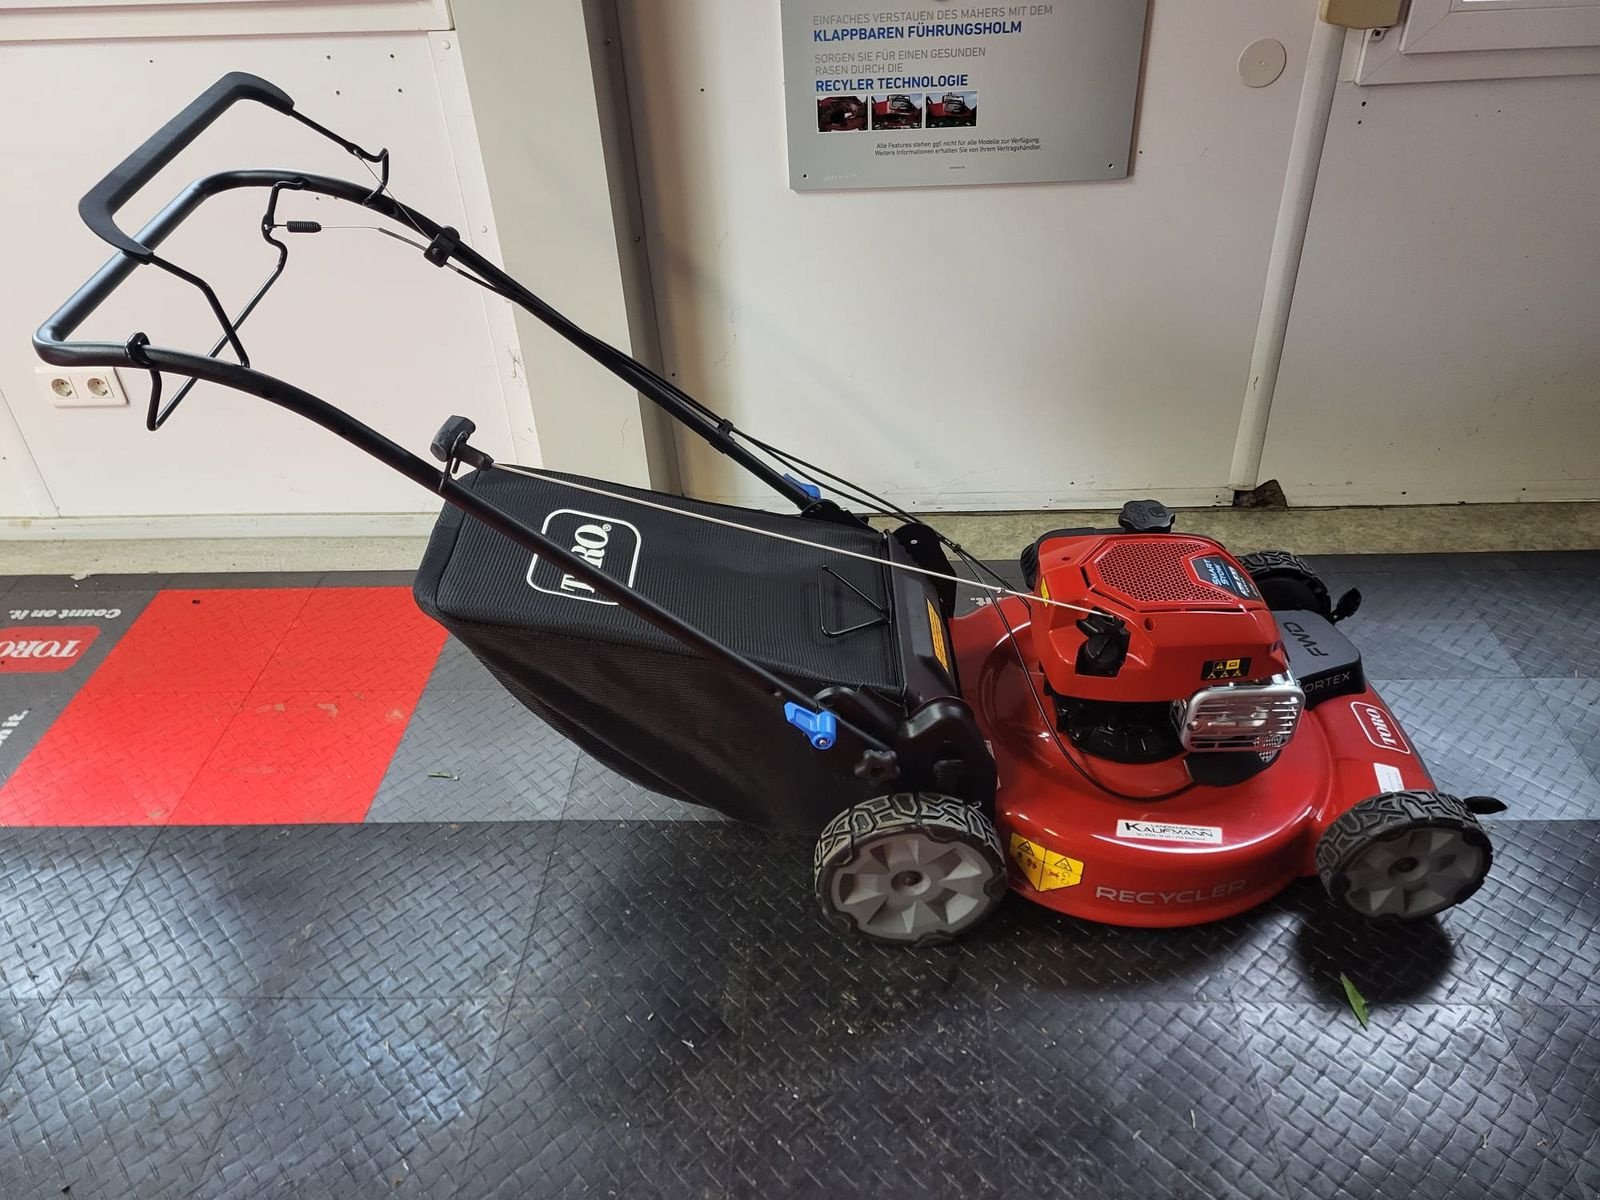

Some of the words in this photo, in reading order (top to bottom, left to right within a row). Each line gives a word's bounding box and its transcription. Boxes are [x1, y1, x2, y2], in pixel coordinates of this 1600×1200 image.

[812, 13, 870, 26] EINFACHES
[872, 10, 934, 23] VERSTAUEN
[937, 9, 958, 21] DES
[1008, 5, 1027, 17] MIT
[1029, 4, 1053, 16] DEM
[813, 26, 904, 42] KLAPPBAREN
[907, 20, 1022, 38] FÜHRUNGSHOLM
[815, 53, 855, 64] SORGEN
[857, 51, 873, 62] SIE
[898, 49, 928, 60] EINEN
[930, 47, 986, 59] GESUNDEN
[815, 64, 849, 76] RASEN
[850, 63, 885, 75] DURCH
[887, 62, 904, 73] DIE
[815, 78, 875, 92] RECYLER
[876, 74, 969, 90] TECHNOLOGIE
[896, 148, 934, 156] Informationen
[1203, 558, 1222, 586] SMART
[1213, 563, 1230, 586] STOW
[8, 609, 30, 620] it.
[30, 610, 57, 619] on
[58, 608, 122, 619] Count
[1282, 621, 1330, 657] FWD
[1365, 707, 1398, 746] TORO
[1124, 821, 1214, 838] KAUFMANN
[1095, 878, 1247, 904] RECYCLER
